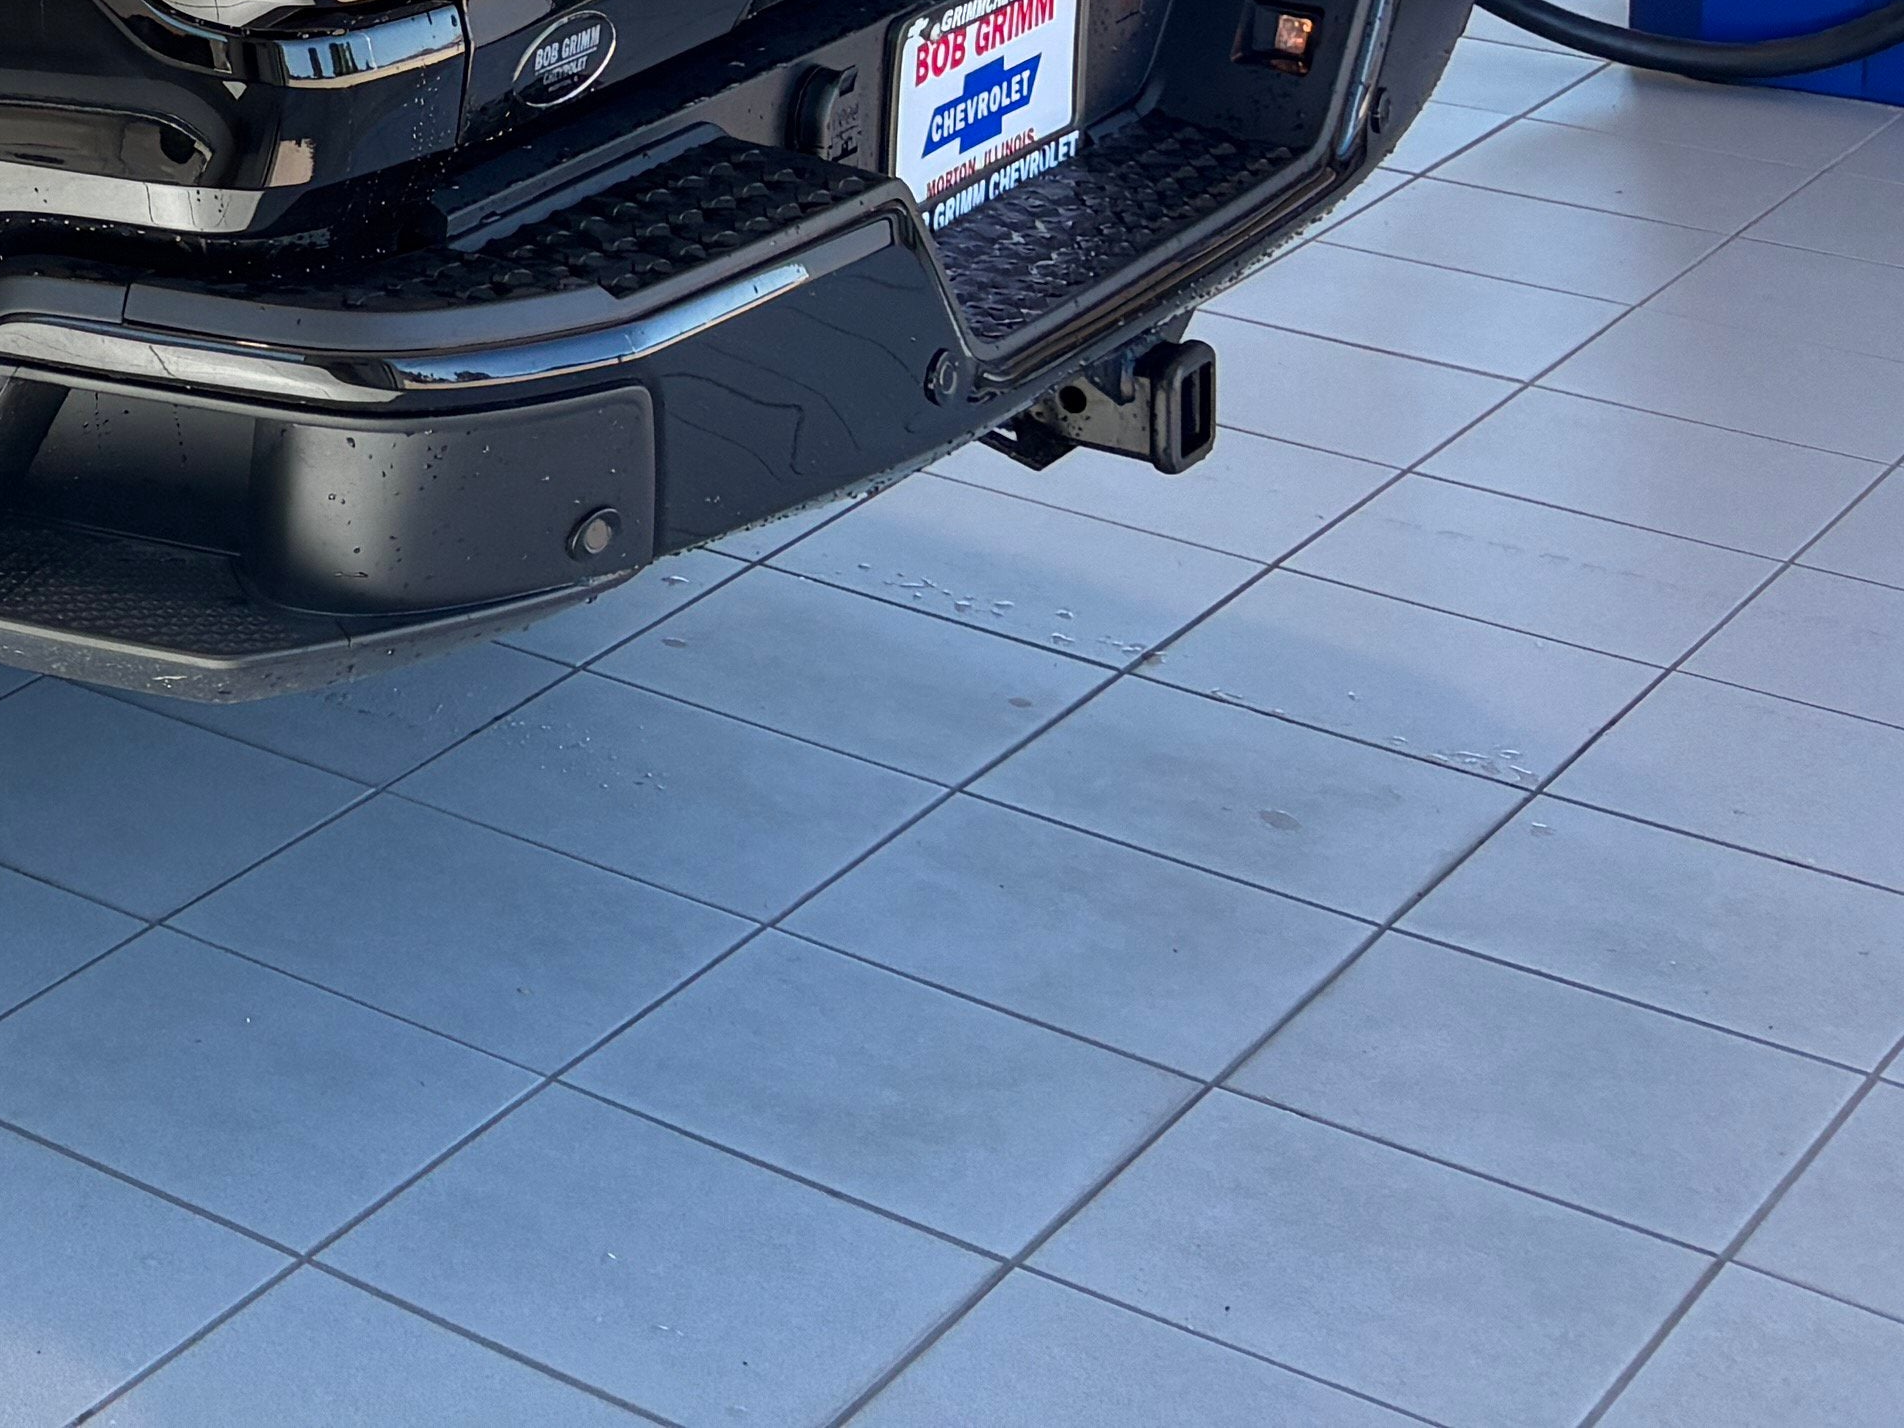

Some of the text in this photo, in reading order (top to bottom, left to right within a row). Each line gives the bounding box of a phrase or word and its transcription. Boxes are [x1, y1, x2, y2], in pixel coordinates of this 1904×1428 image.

[535, 24, 601, 71] BOB GRIMM
[915, 28, 967, 88] BOB
[931, 69, 1031, 142] CHEVROLET
[933, 130, 1079, 232] GRIMM CHEVROLET
